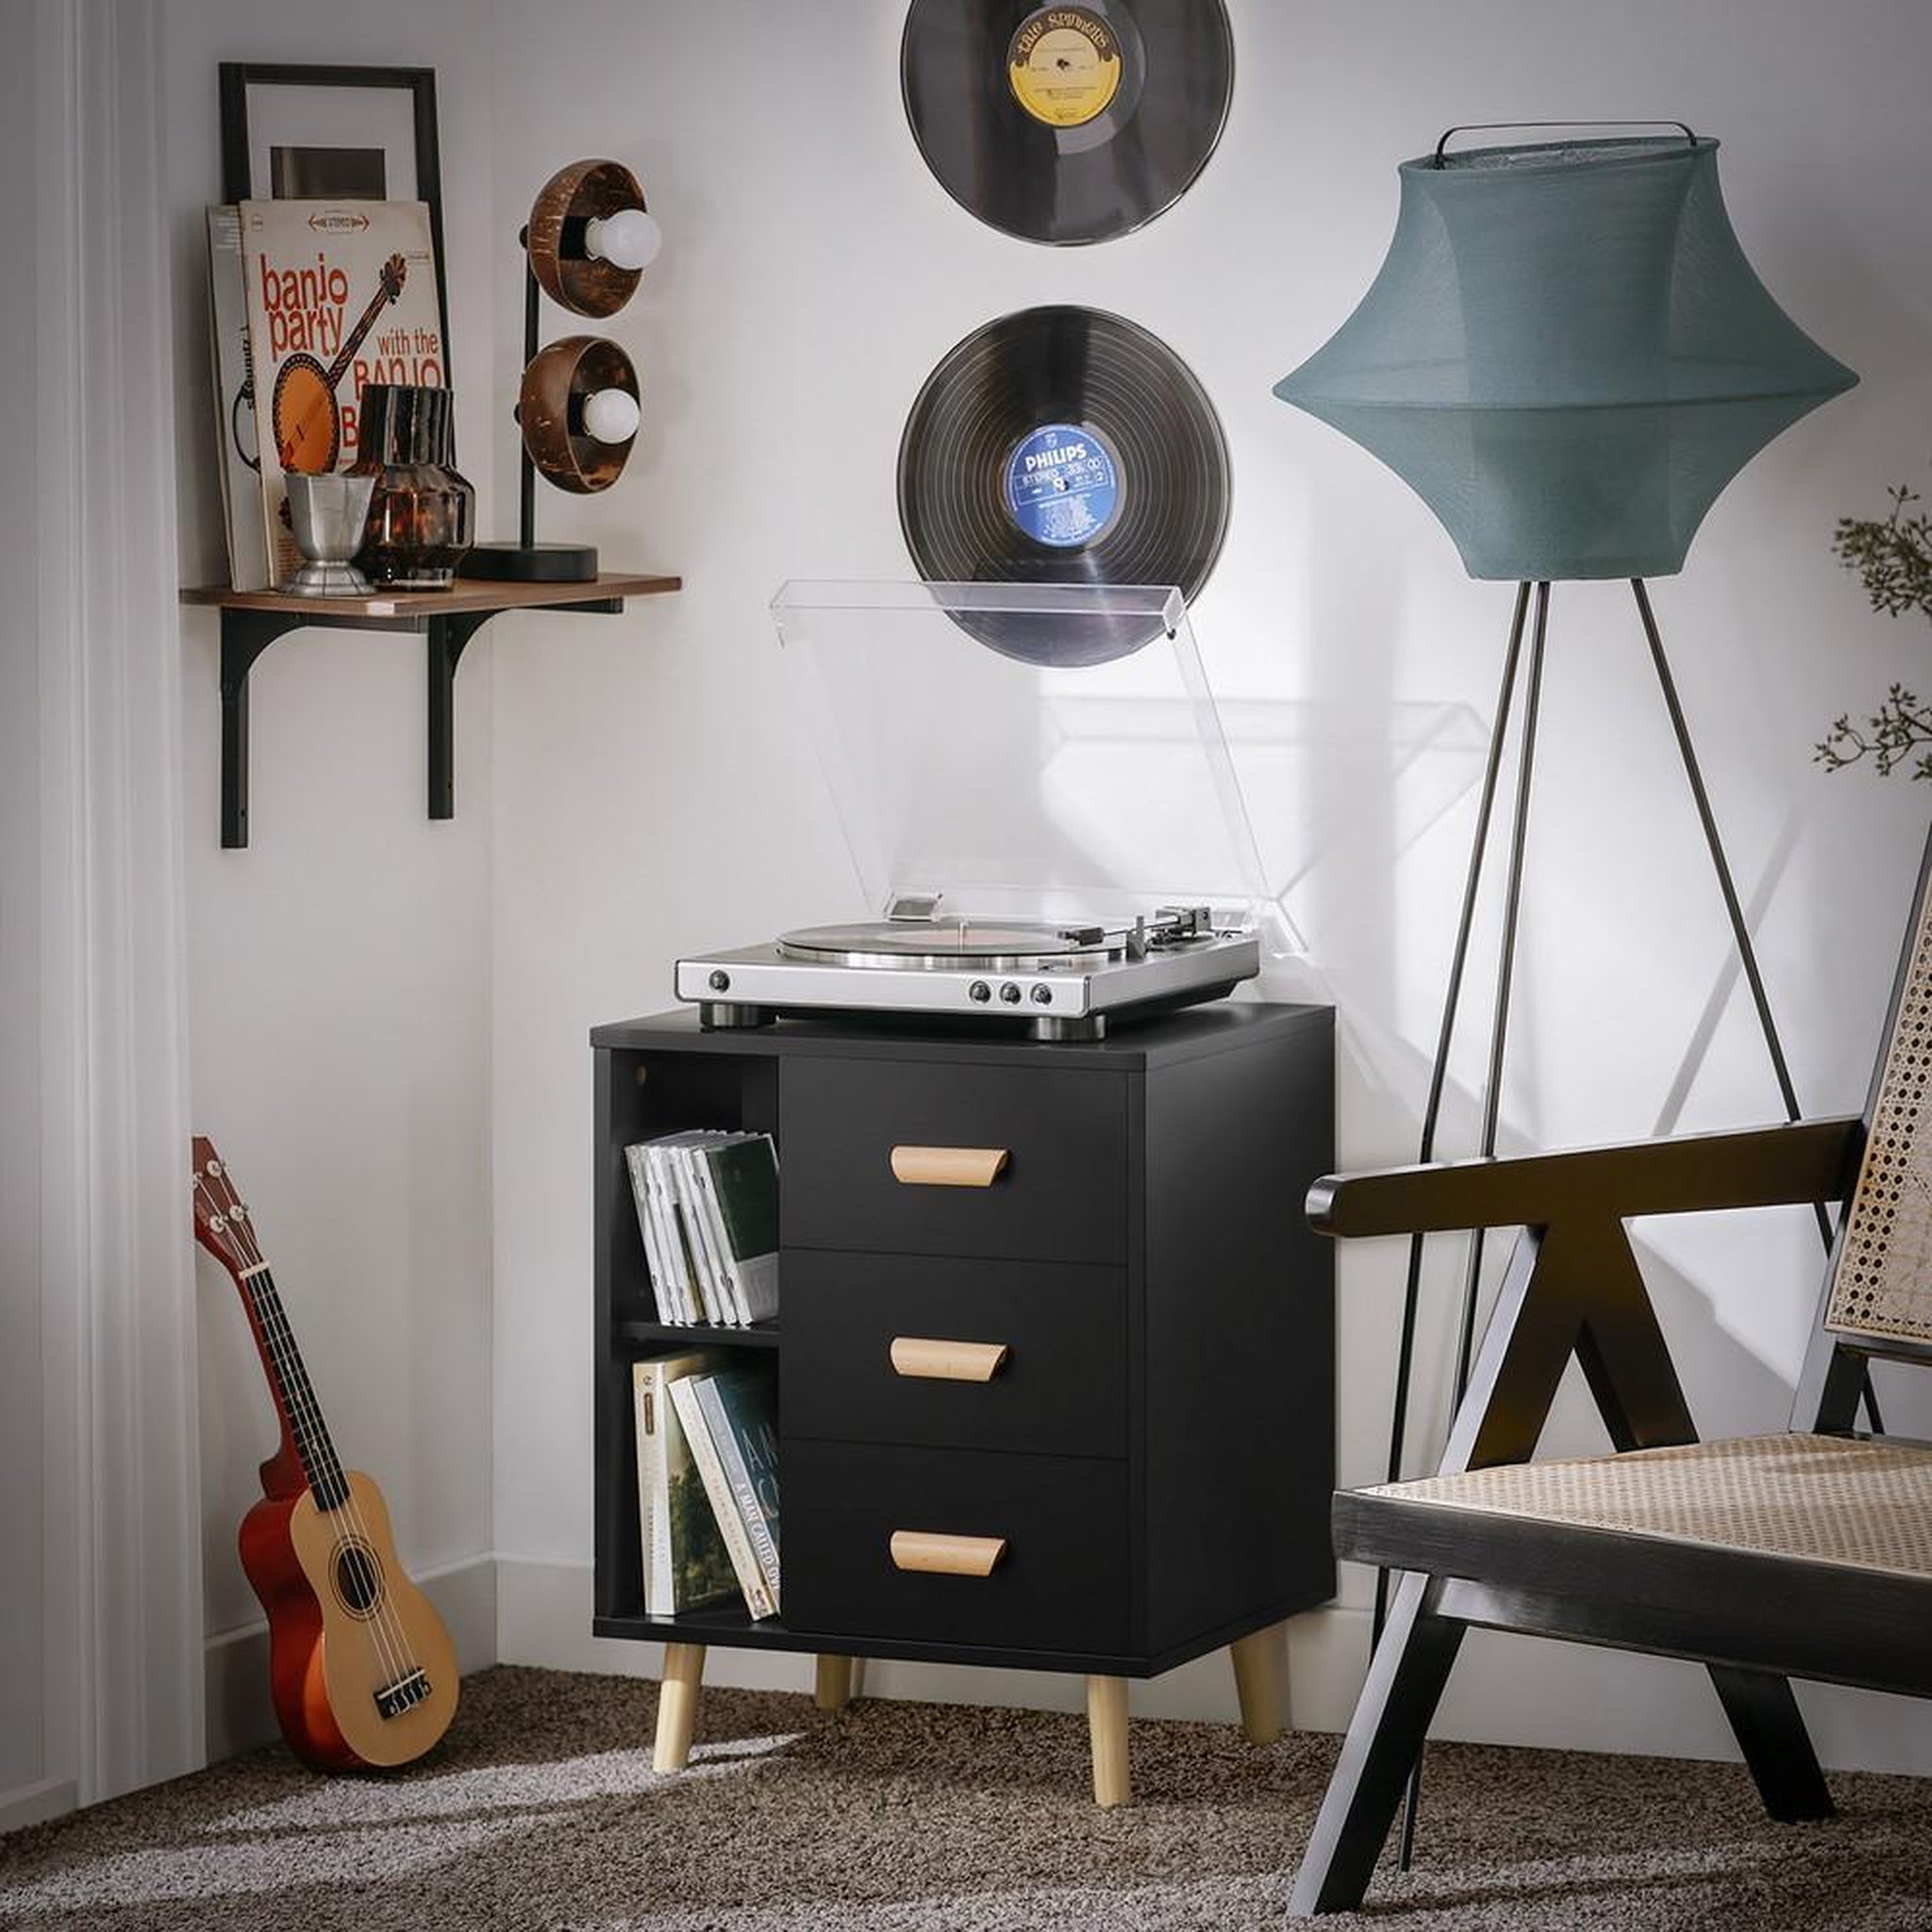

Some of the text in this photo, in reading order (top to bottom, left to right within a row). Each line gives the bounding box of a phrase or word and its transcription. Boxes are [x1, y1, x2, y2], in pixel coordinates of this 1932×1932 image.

[259, 252, 349, 311] banjo
[268, 303, 343, 362] party
[378, 326, 439, 356] with the
[1024, 442, 1088, 473] PHILIPS
